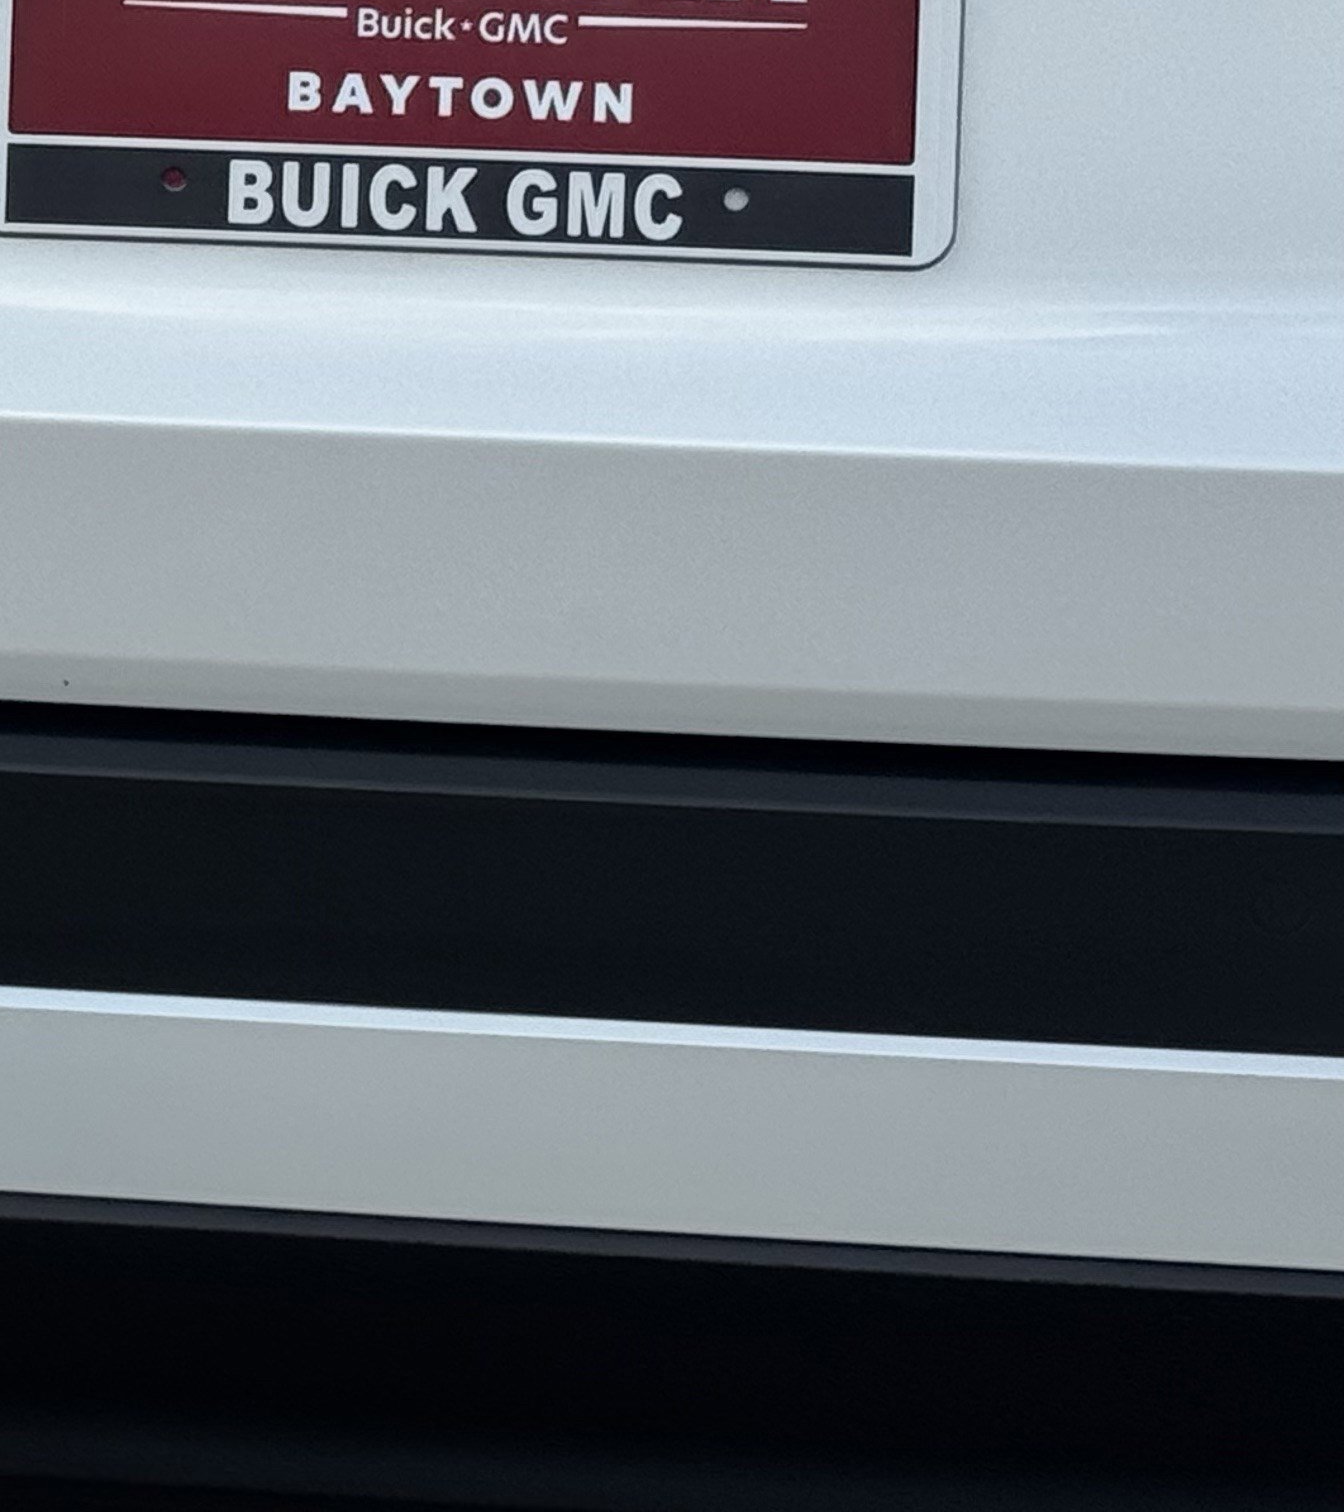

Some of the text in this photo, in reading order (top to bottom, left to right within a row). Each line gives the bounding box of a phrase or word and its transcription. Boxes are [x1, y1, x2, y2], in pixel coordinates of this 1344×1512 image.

[357, 7, 568, 45] Buick GMC
[287, 71, 634, 124] BAYTOWN
[227, 159, 684, 242] BUICK GMC
